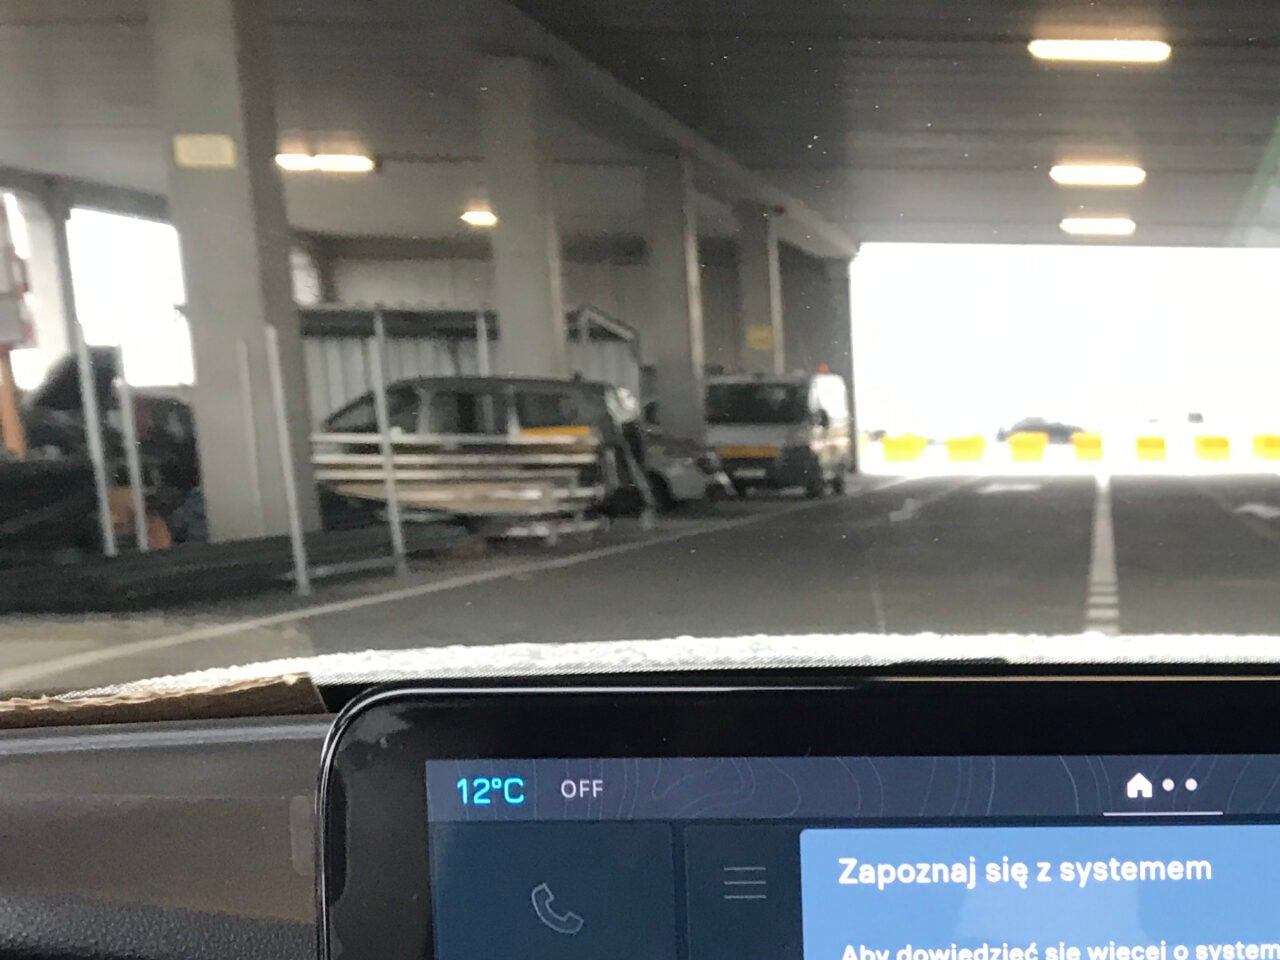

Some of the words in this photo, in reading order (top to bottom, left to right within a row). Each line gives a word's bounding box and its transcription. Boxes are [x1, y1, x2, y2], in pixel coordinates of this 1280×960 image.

[457, 778, 525, 804] 12°C
[560, 779, 604, 799] OFF
[838, 856, 977, 890] Zapoznaj
[985, 856, 1029, 889] się
[1036, 861, 1053, 882] z
[1059, 857, 1213, 888] systemem
[1173, 945, 1189, 960] o
